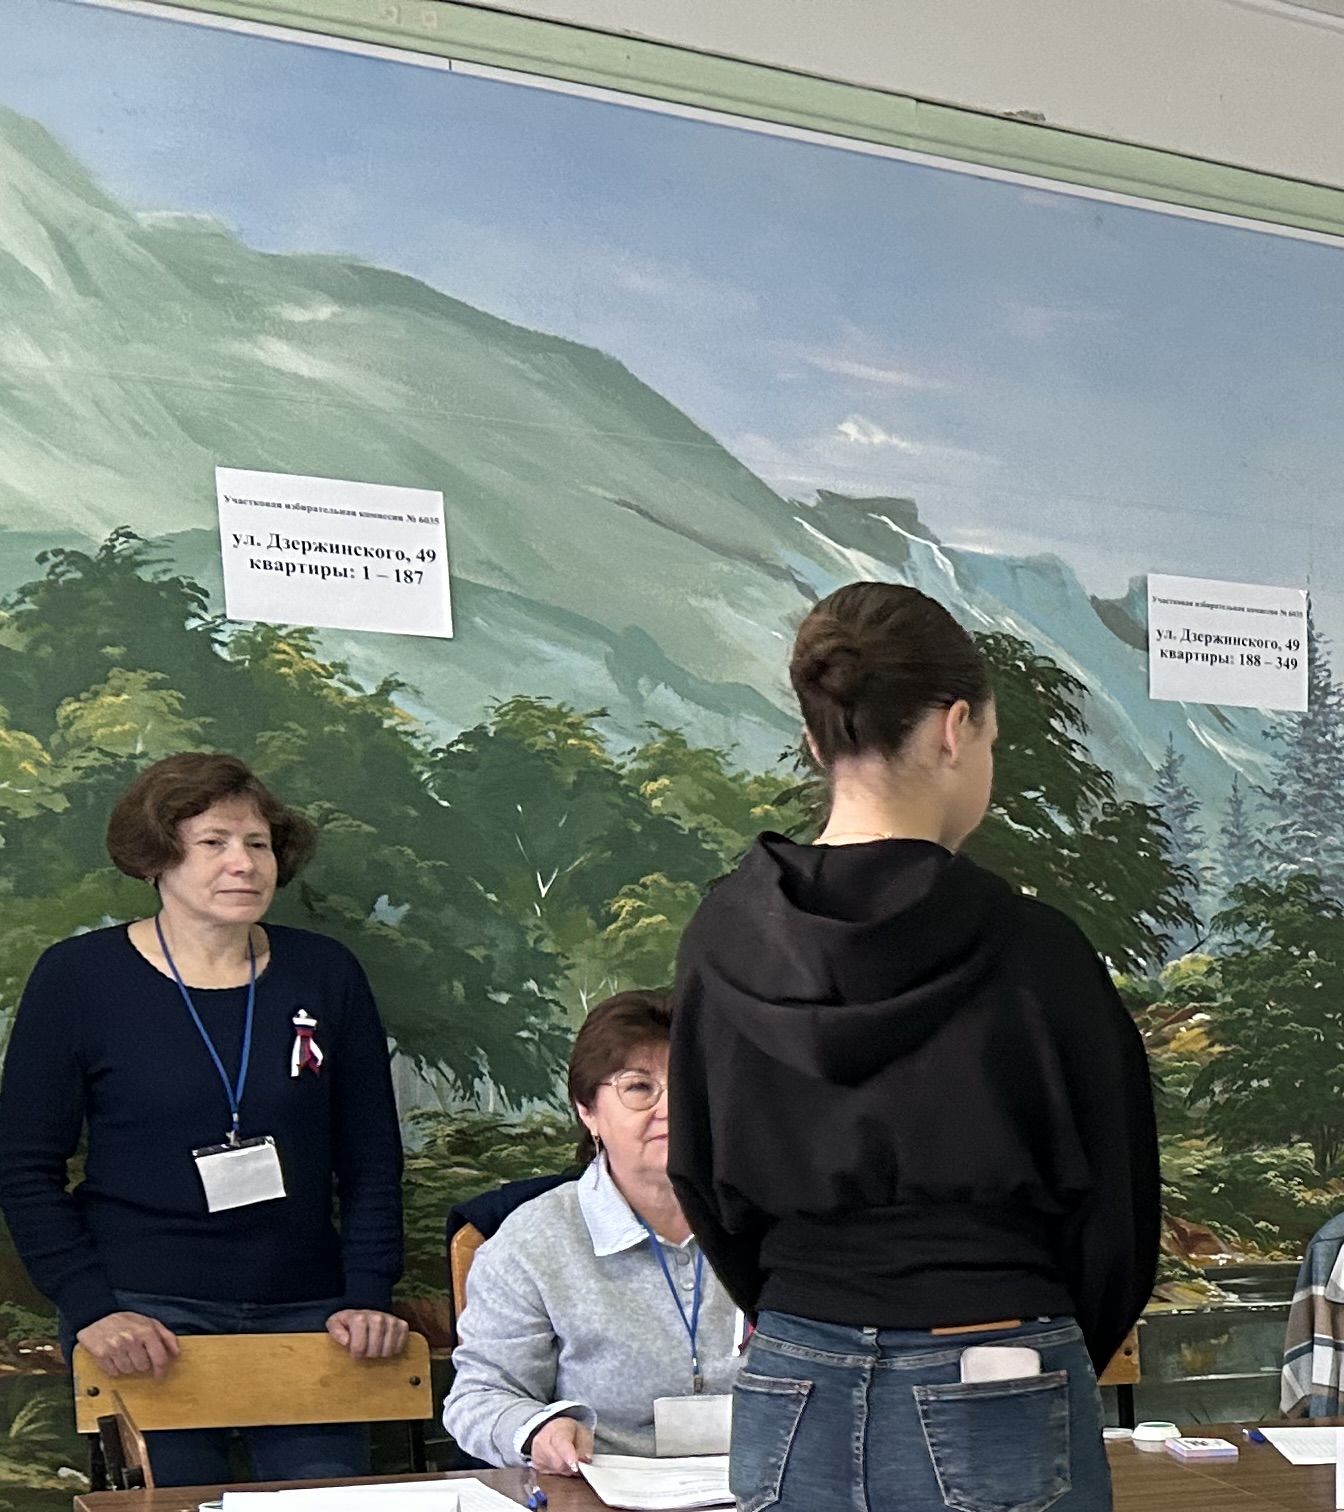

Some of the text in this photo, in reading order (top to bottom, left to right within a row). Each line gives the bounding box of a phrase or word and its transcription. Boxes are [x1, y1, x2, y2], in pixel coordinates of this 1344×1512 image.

[223, 494, 282, 509] Участковая
[285, 502, 356, 518] избирательная
[359, 511, 403, 522] комиссии
[406, 514, 417, 523] №
[232, 532, 437, 563] ул. Дзержинского, 49
[249, 558, 355, 580] квартиры:
[362, 566, 370, 580] 1
[394, 568, 424, 585] 187
[1156, 628, 1300, 651] ул. Дзержинского, 49
[1160, 648, 1234, 666] квартиры:
[1239, 653, 1261, 666] 188
[1275, 657, 1298, 670] 349
